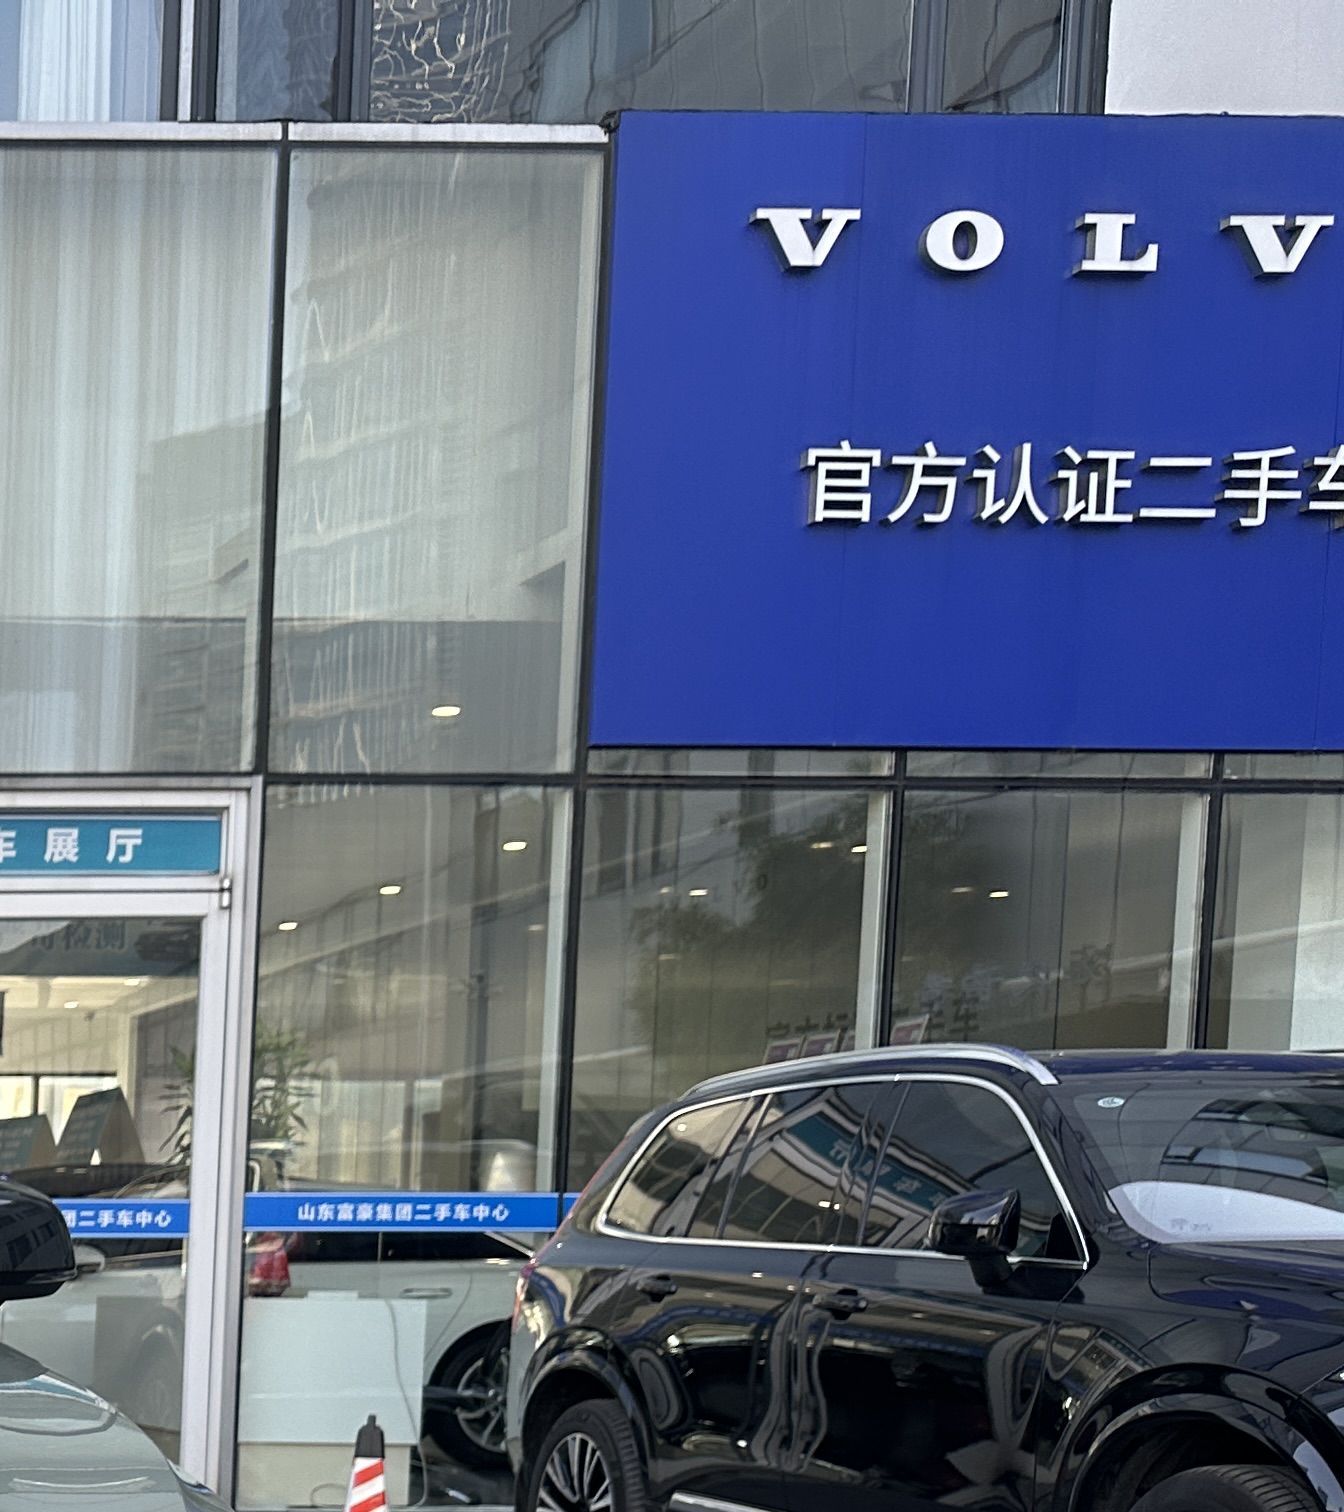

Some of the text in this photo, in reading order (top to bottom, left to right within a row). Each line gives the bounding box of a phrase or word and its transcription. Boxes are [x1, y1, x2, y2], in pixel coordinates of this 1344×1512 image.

[297, 1202, 510, 1222] 山东富豪集团二手车中心
